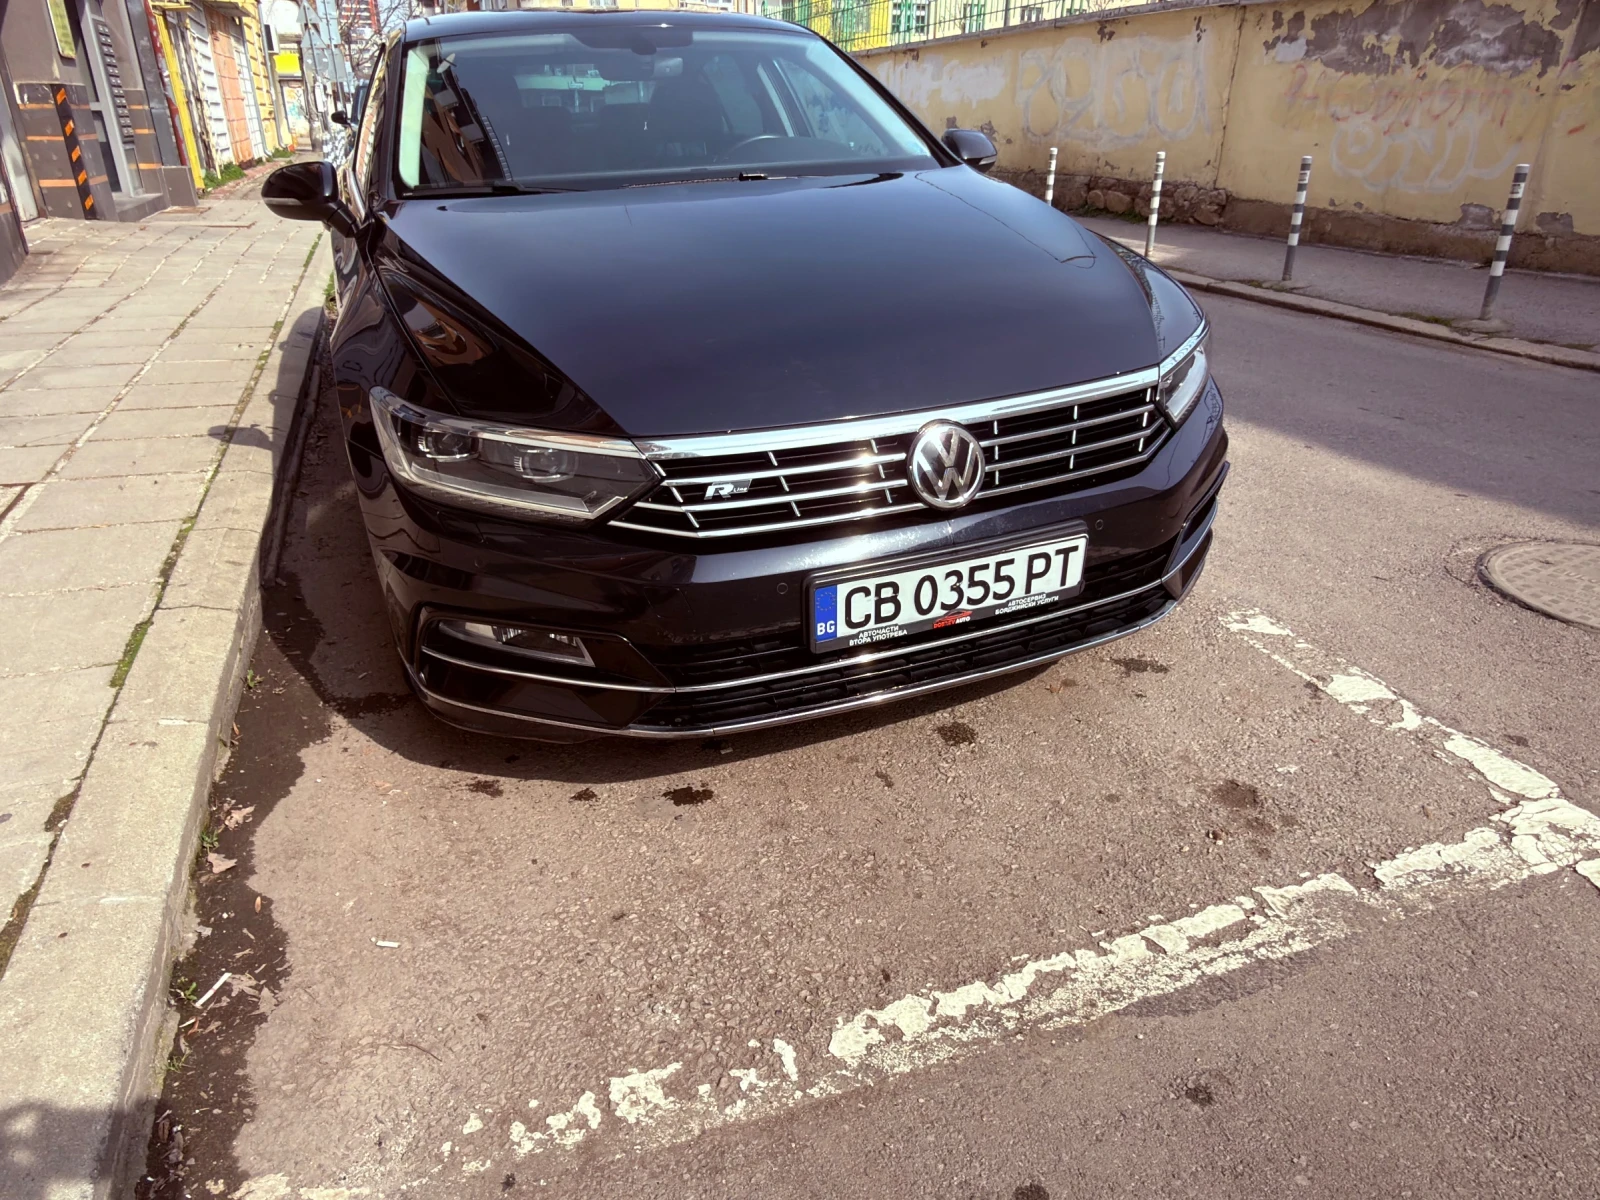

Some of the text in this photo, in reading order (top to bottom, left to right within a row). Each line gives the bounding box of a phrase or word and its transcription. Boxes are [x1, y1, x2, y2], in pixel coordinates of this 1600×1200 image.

[845, 545, 1079, 630] CB 0355 PT
[817, 620, 835, 636] BG
[859, 625, 899, 639] АВТОЧАСТИ
[849, 629, 908, 646] ВТОРА УПОТРЕБА
